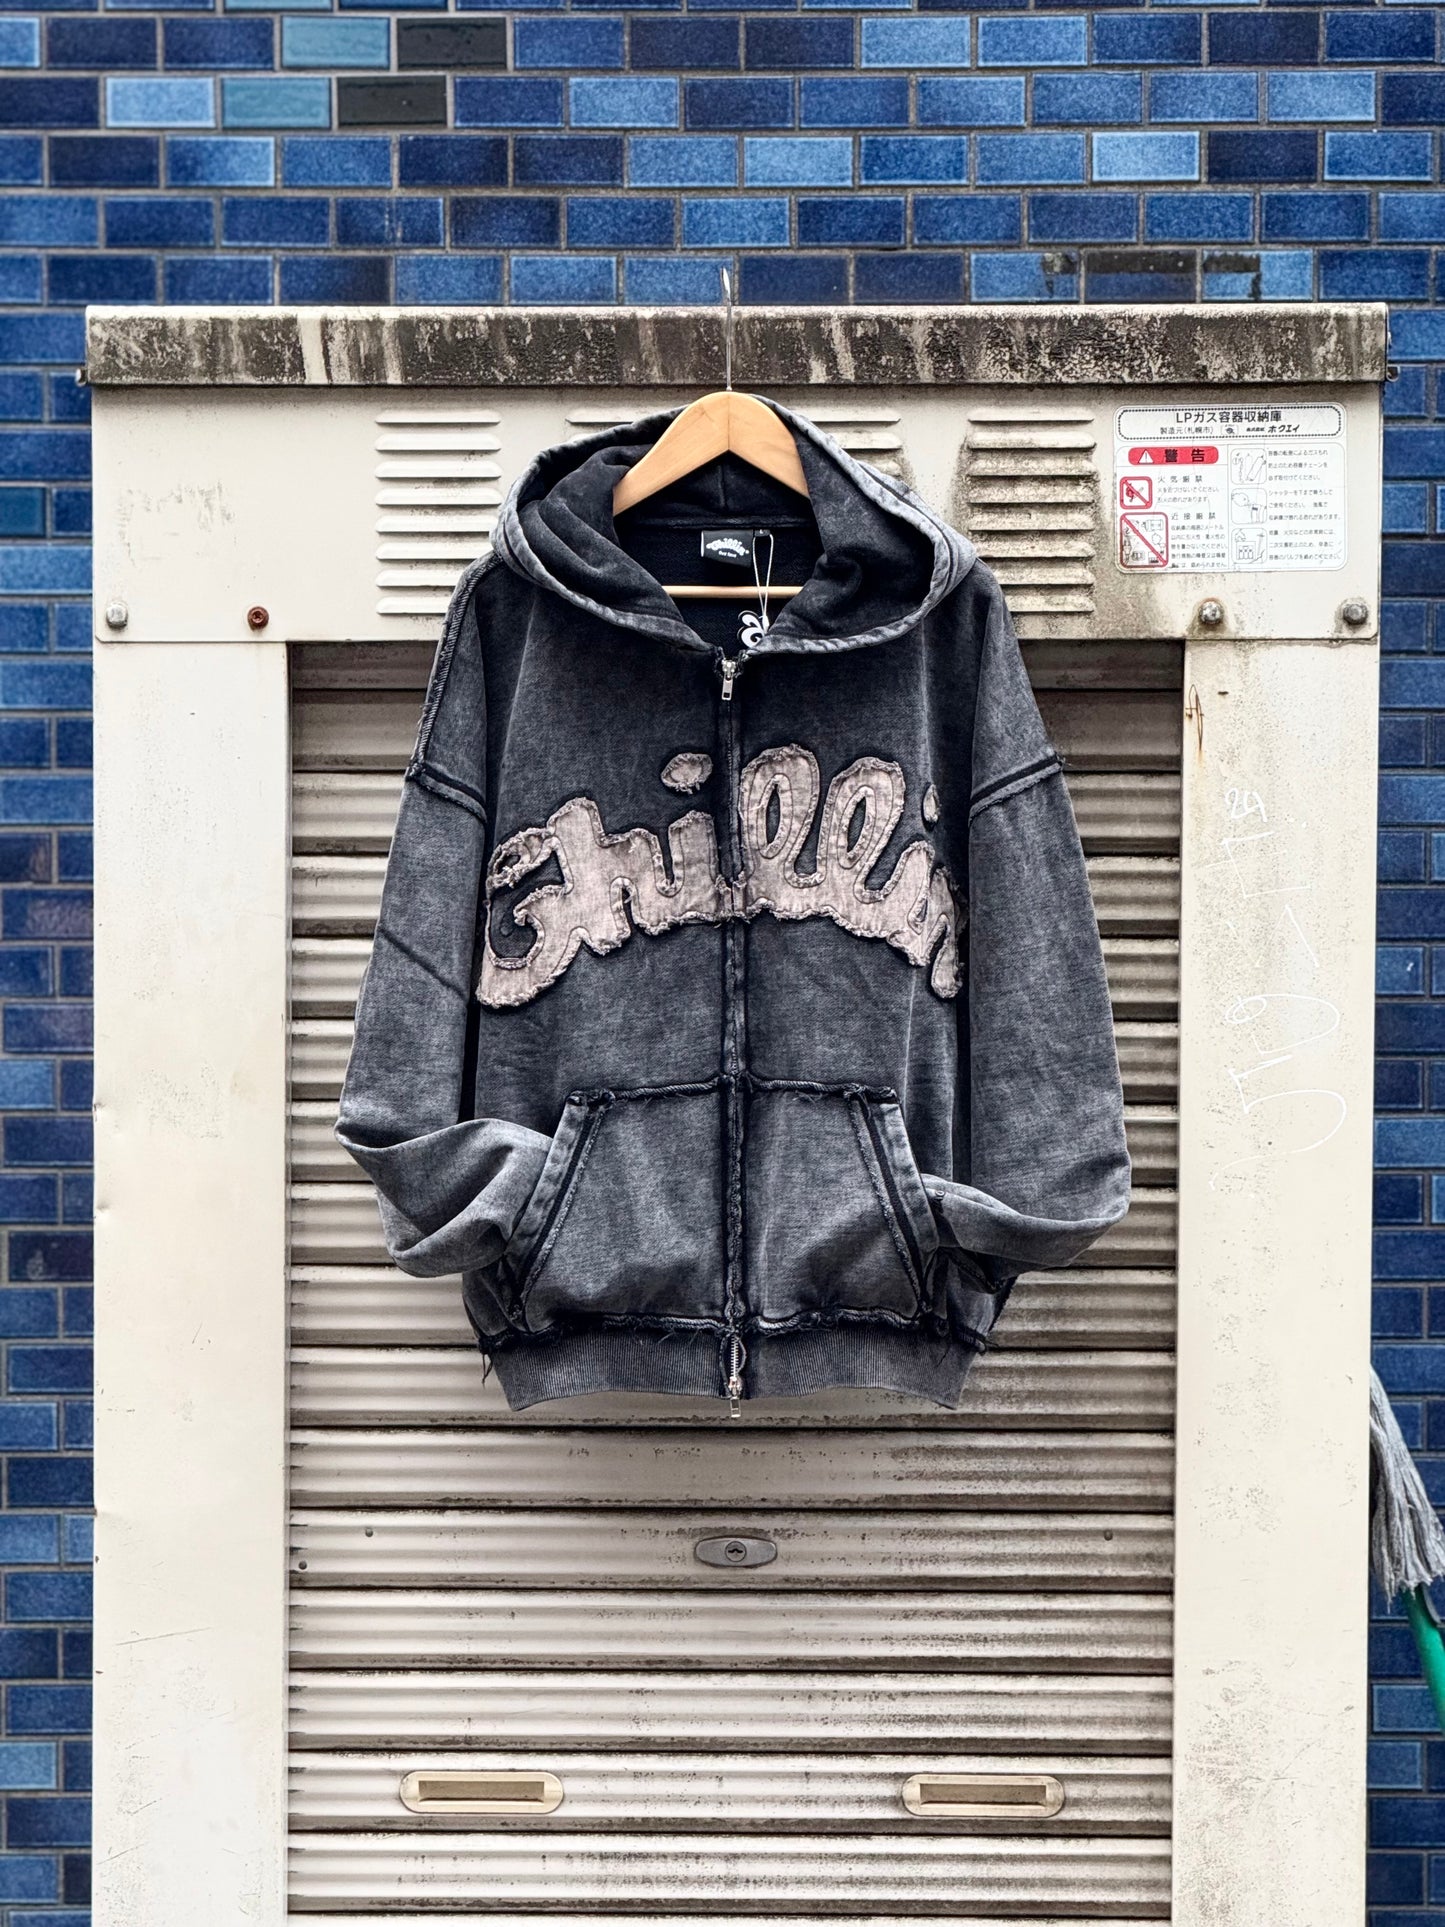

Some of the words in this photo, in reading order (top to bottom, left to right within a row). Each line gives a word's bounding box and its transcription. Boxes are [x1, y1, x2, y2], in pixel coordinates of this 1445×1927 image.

[1176, 410, 1282, 423] LPガス容器収納庫
